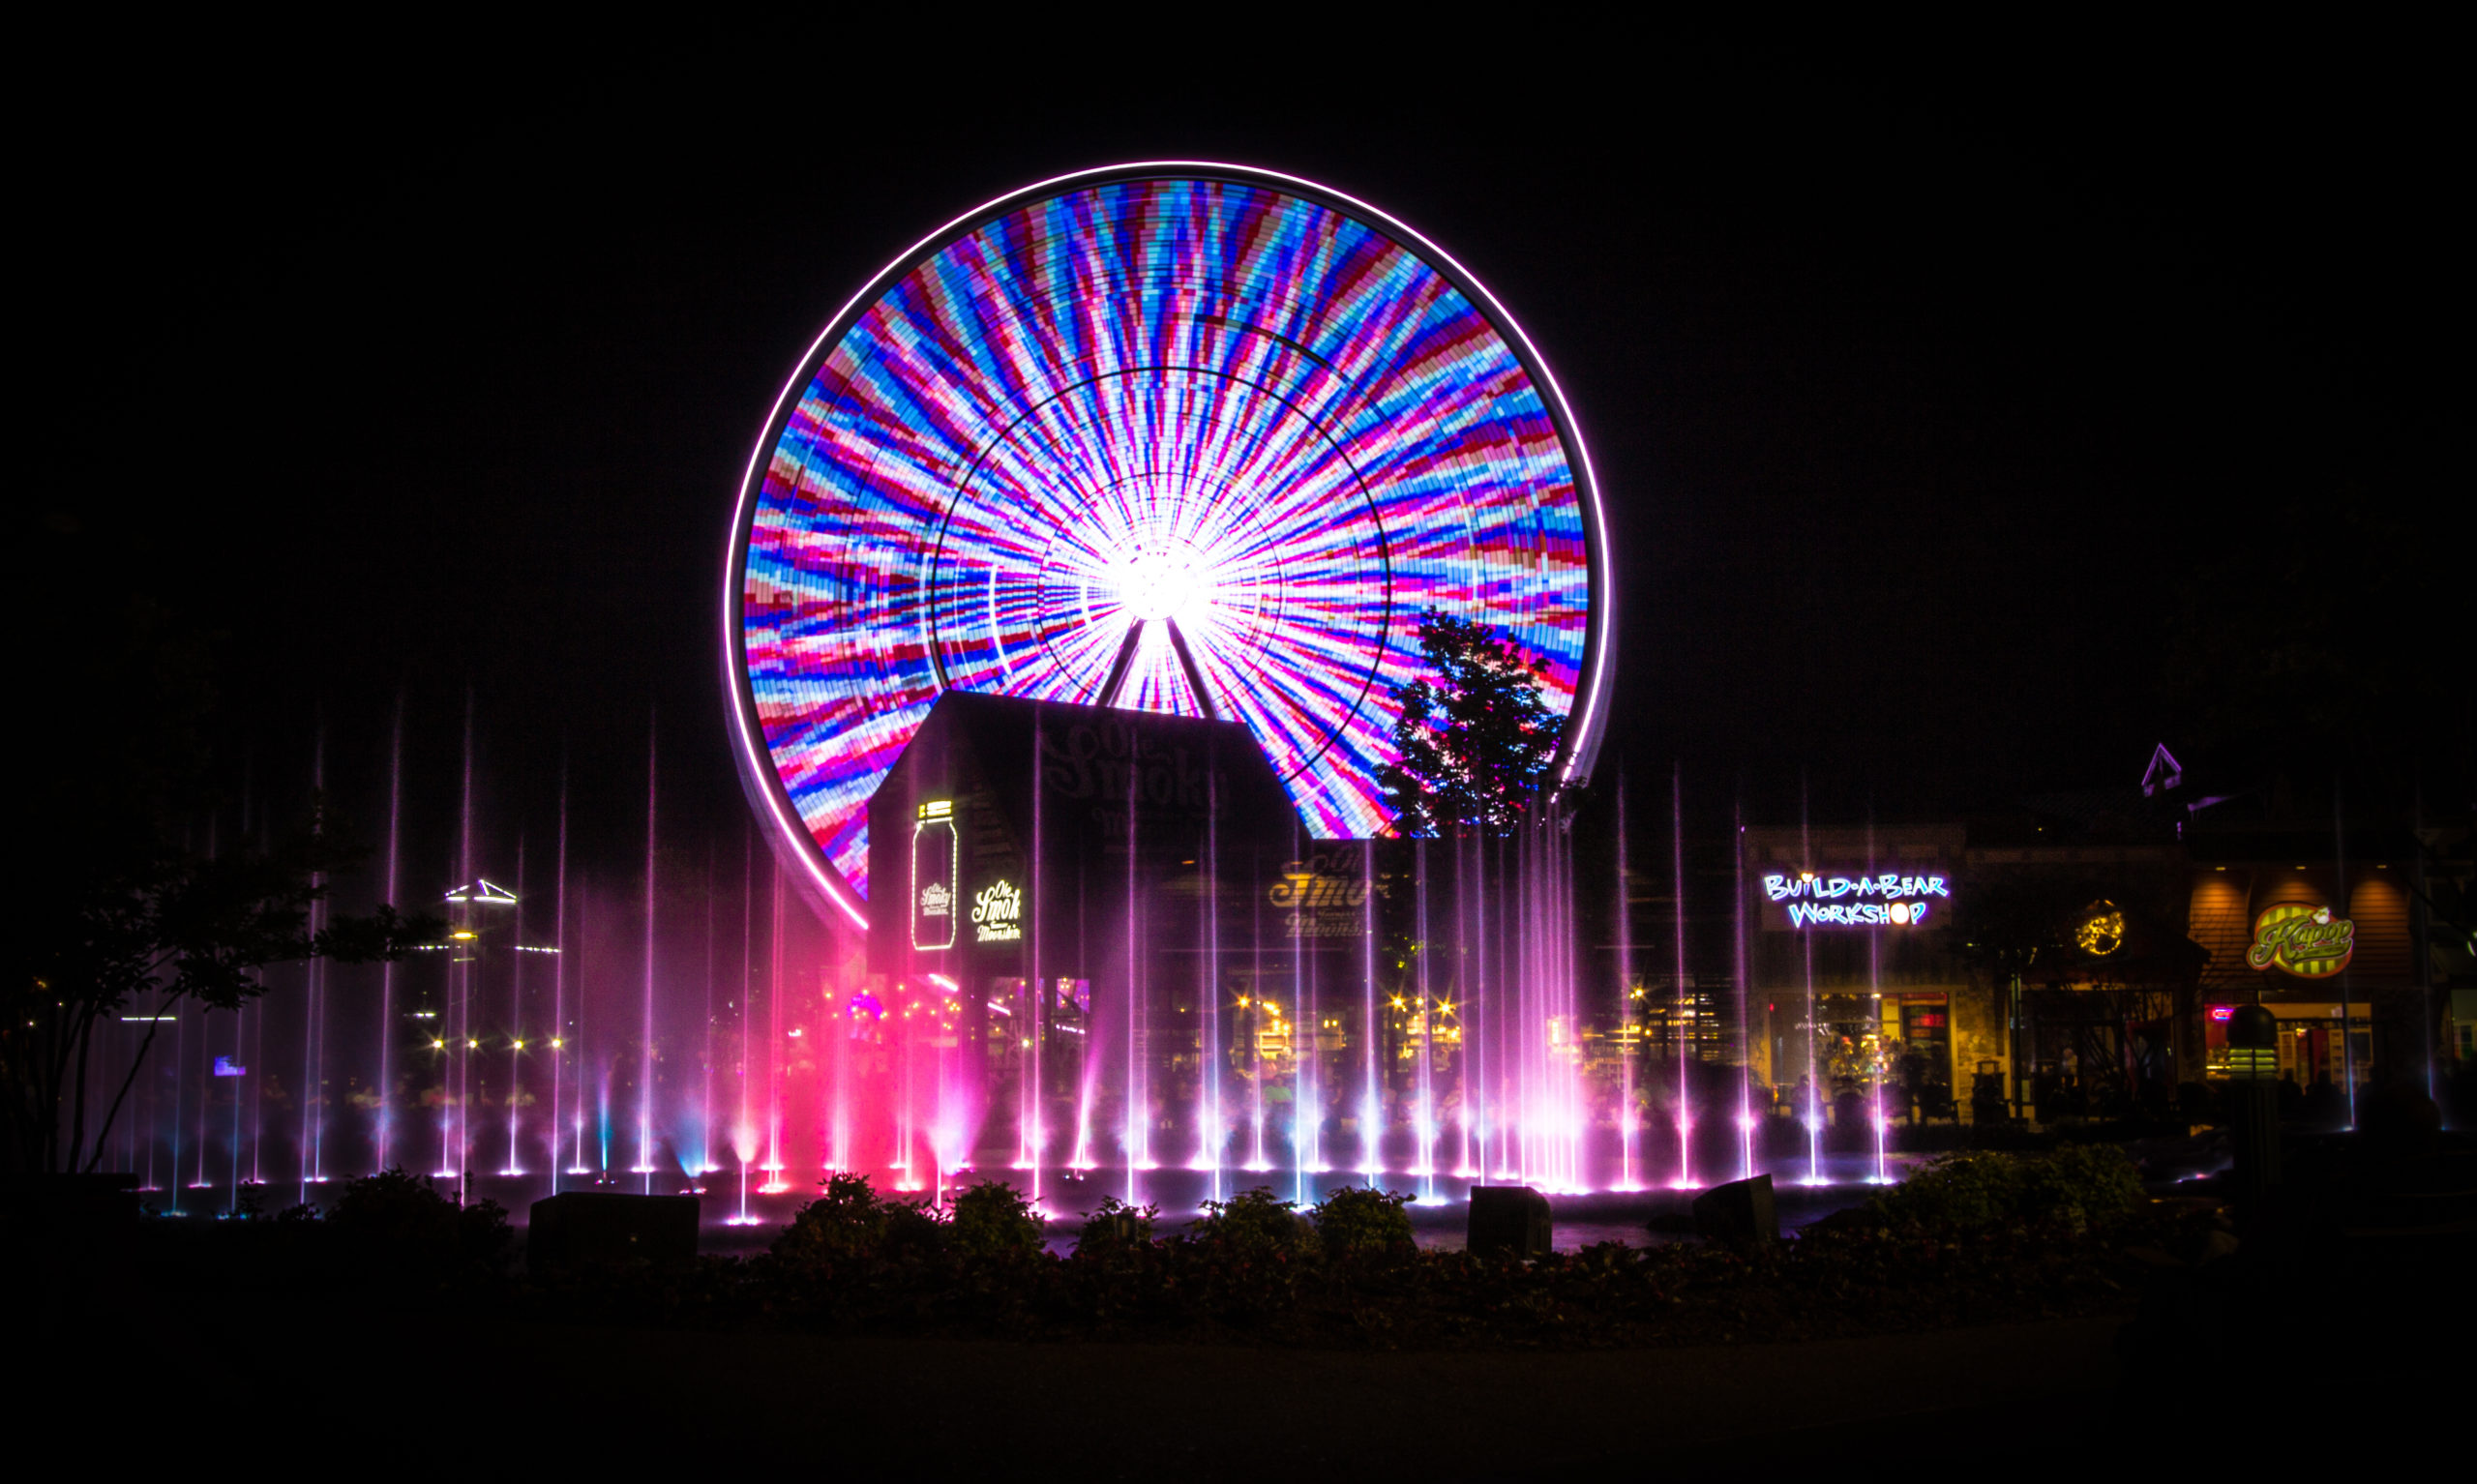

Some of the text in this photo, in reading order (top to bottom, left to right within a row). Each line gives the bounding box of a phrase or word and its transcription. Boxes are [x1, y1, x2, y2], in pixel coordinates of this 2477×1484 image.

[995, 878, 1014, 898] Ole
[1788, 902, 1926, 929] WORKSHOP
[2250, 916, 2354, 966] Kapop
